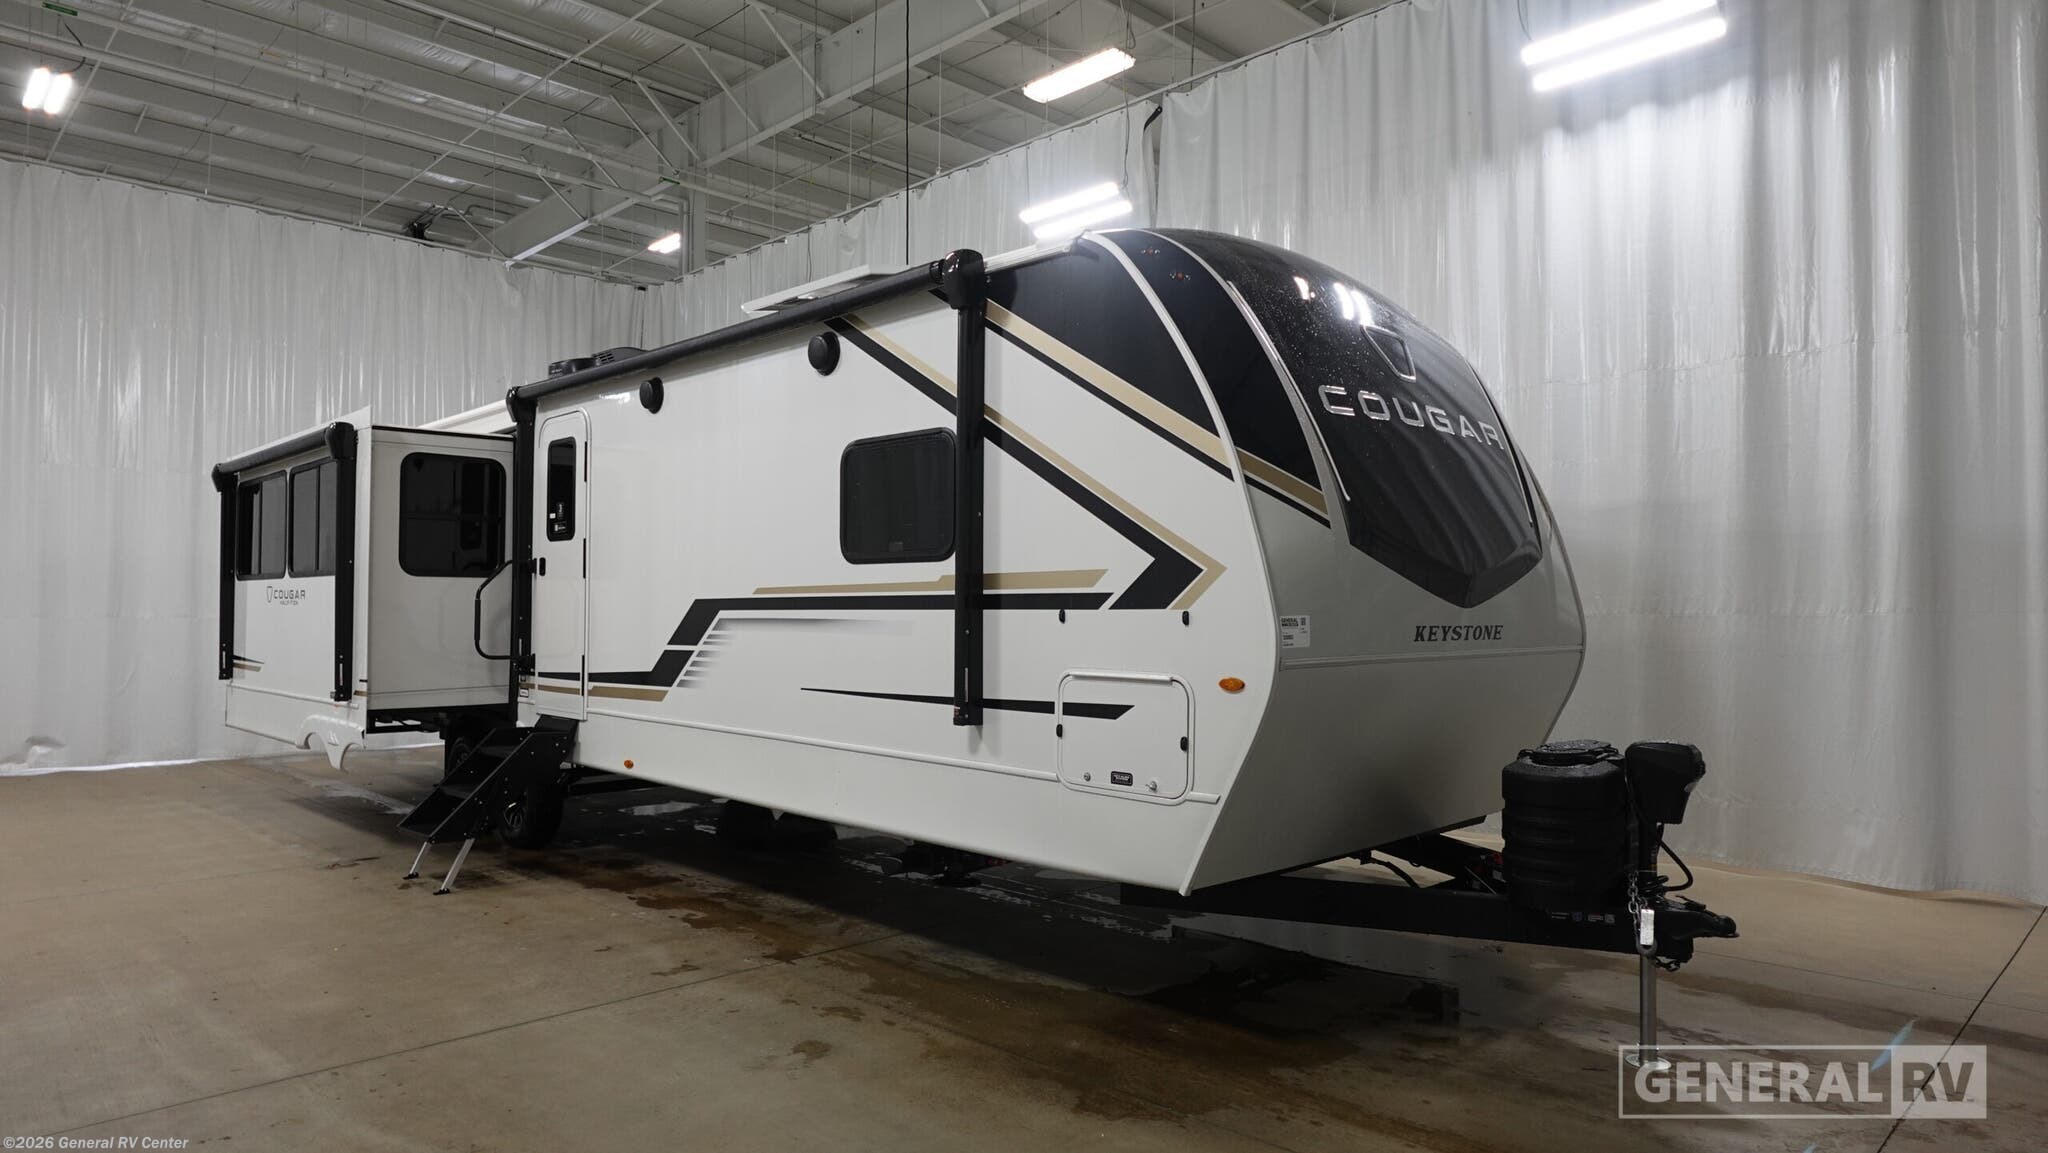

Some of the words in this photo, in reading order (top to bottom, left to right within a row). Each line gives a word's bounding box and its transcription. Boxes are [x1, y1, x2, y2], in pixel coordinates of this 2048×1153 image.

[1318, 385, 1504, 450] COUGAR
[274, 590, 305, 600] COUGAR
[1414, 625, 1503, 642] KEYSTONE
